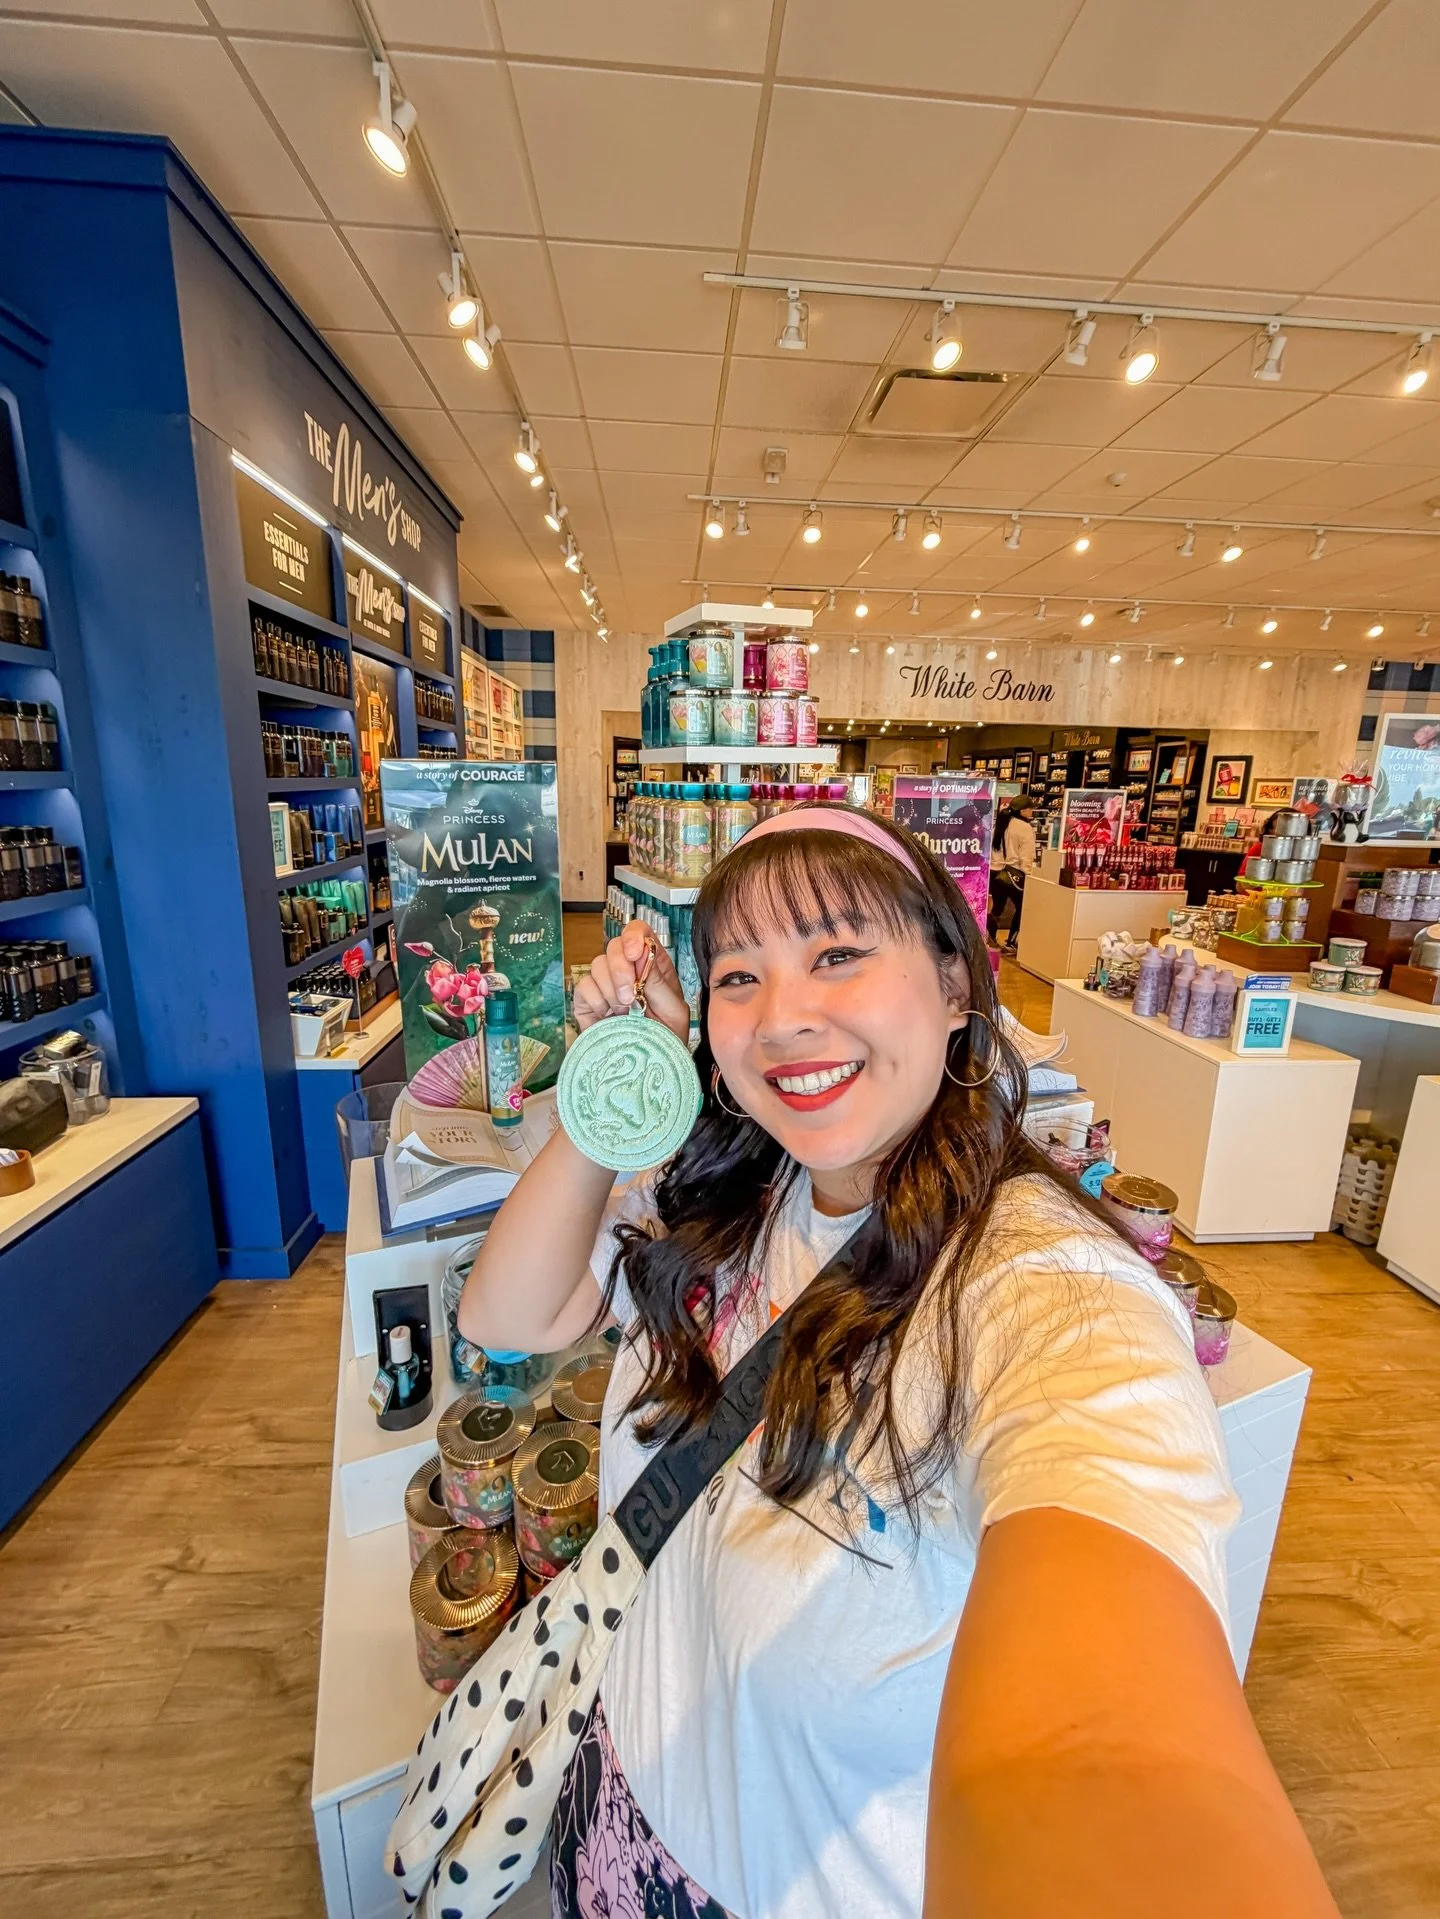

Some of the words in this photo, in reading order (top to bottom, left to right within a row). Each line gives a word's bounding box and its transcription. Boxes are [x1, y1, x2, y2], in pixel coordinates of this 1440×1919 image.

[304, 411, 333, 474] THE
[333, 423, 402, 547] Men's
[401, 510, 422, 552] SHOP
[263, 521, 309, 565] ESSENTIALS
[271, 549, 288, 576] FOR
[289, 558, 306, 583] MEN
[899, 664, 977, 699] White
[982, 668, 1056, 702] Barn
[424, 771, 449, 782] story
[449, 770, 460, 781] of
[460, 770, 525, 782] COURAGE
[939, 784, 978, 794] OPTIMISM
[1070, 799, 1102, 809] blooming
[443, 814, 506, 825] PRINCESS
[926, 817, 963, 825] PRINCESS
[417, 877, 453, 888] Magnolia
[454, 876, 488, 885] blossom,
[489, 875, 511, 883] fierce
[512, 874, 537, 882] waters
[454, 885, 481, 893] radiant
[482, 884, 510, 894] apricot
[509, 928, 545, 945] new!
[1246, 1023, 1280, 1035] FREE
